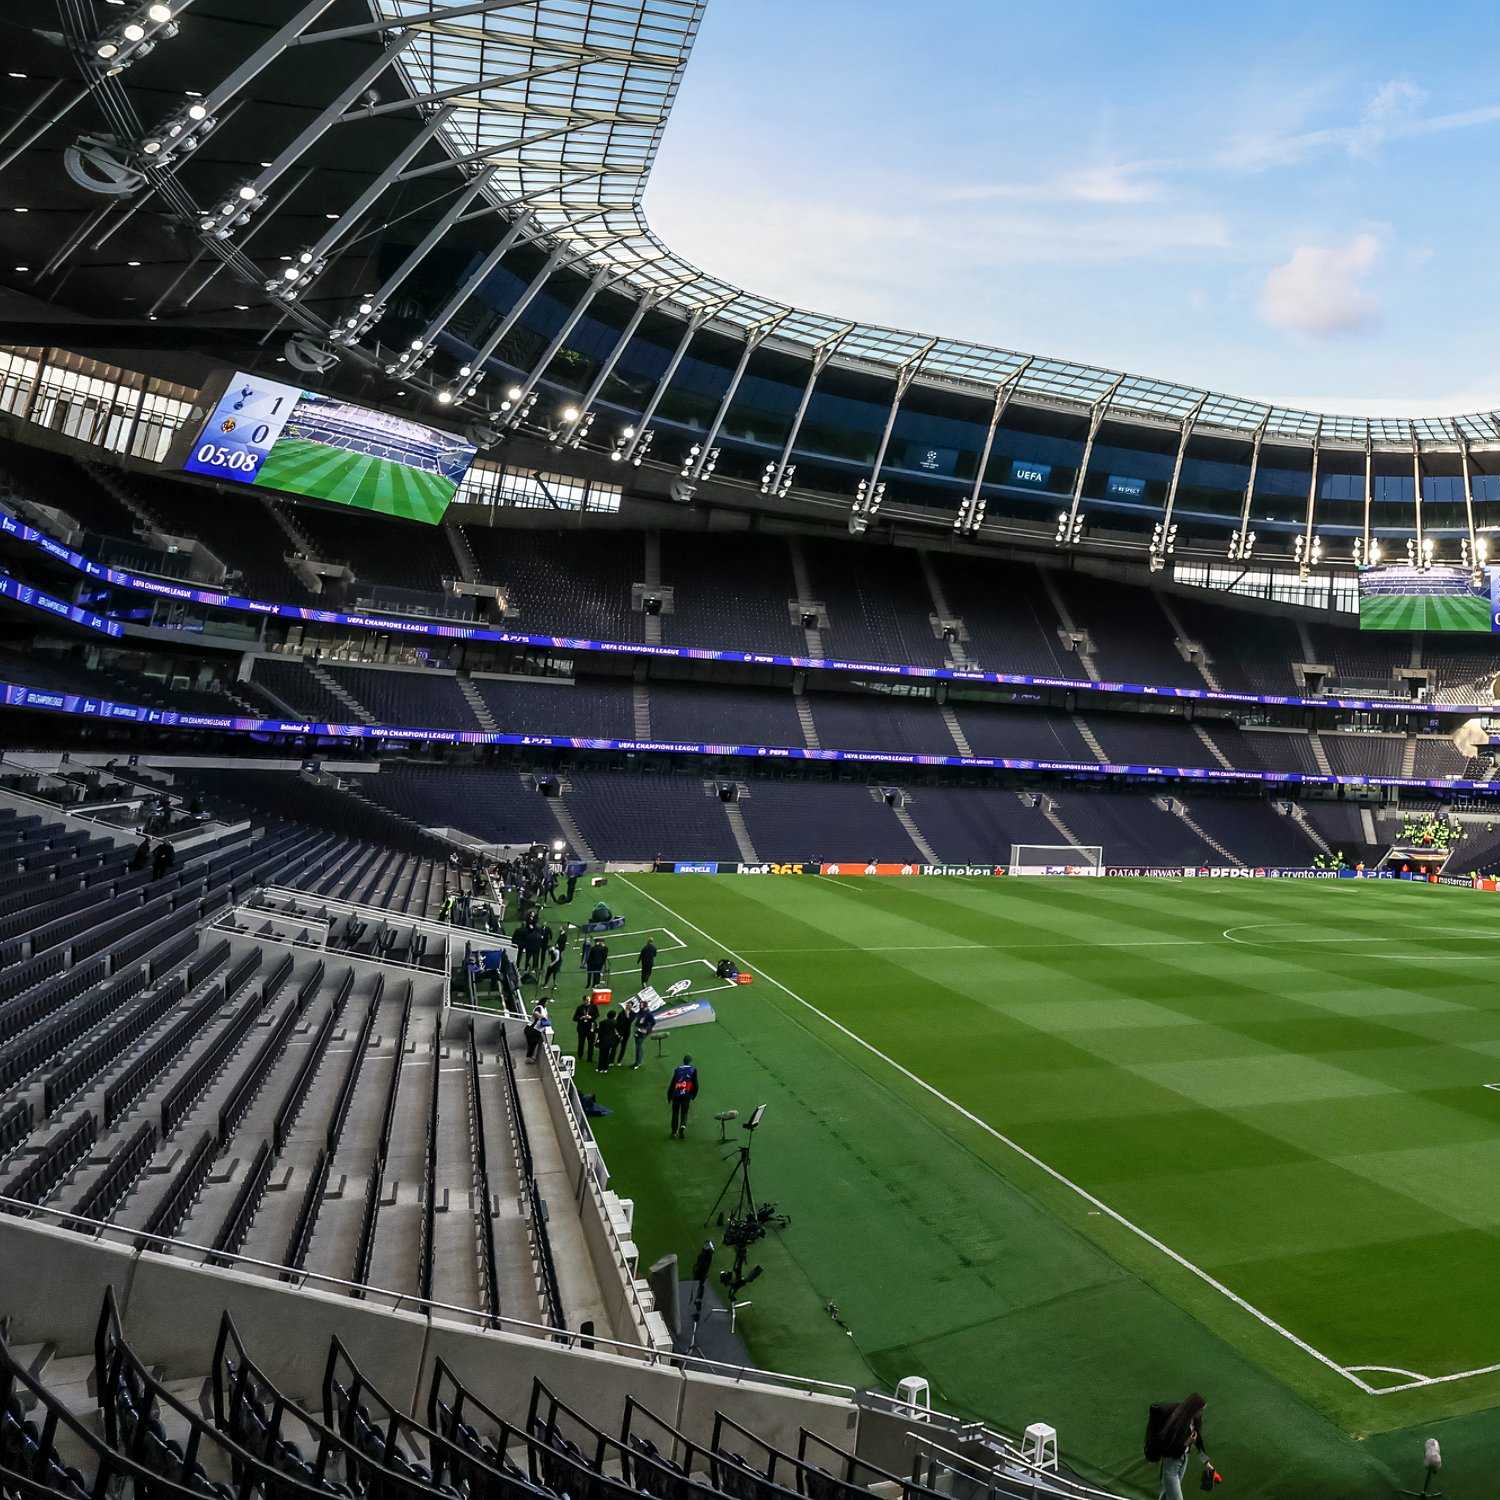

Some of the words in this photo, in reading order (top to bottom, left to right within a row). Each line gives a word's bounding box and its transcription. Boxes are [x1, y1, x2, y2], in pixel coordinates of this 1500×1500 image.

[270, 396, 284, 416] 1
[252, 425, 270, 444] 0
[197, 444, 259, 472] 05:08
[1016, 470, 1042, 483] UEFA
[347, 616, 364, 626] UEFA
[364, 618, 402, 630] CHAMPIONS
[402, 623, 428, 632] LEAGUE
[618, 645, 655, 654] CHAMPIONS
[656, 648, 680, 656] LEAGUE
[389, 730, 428, 738] CHAMPIONS
[737, 864, 804, 874] bet365
[924, 865, 990, 876] Heineken
[1109, 868, 1140, 877] QATAR
[1144, 868, 1182, 877] AIRWAYS
[1210, 868, 1254, 878] PEPSI
[1282, 870, 1336, 878] crypto.com
[1438, 877, 1472, 887] mastercard
